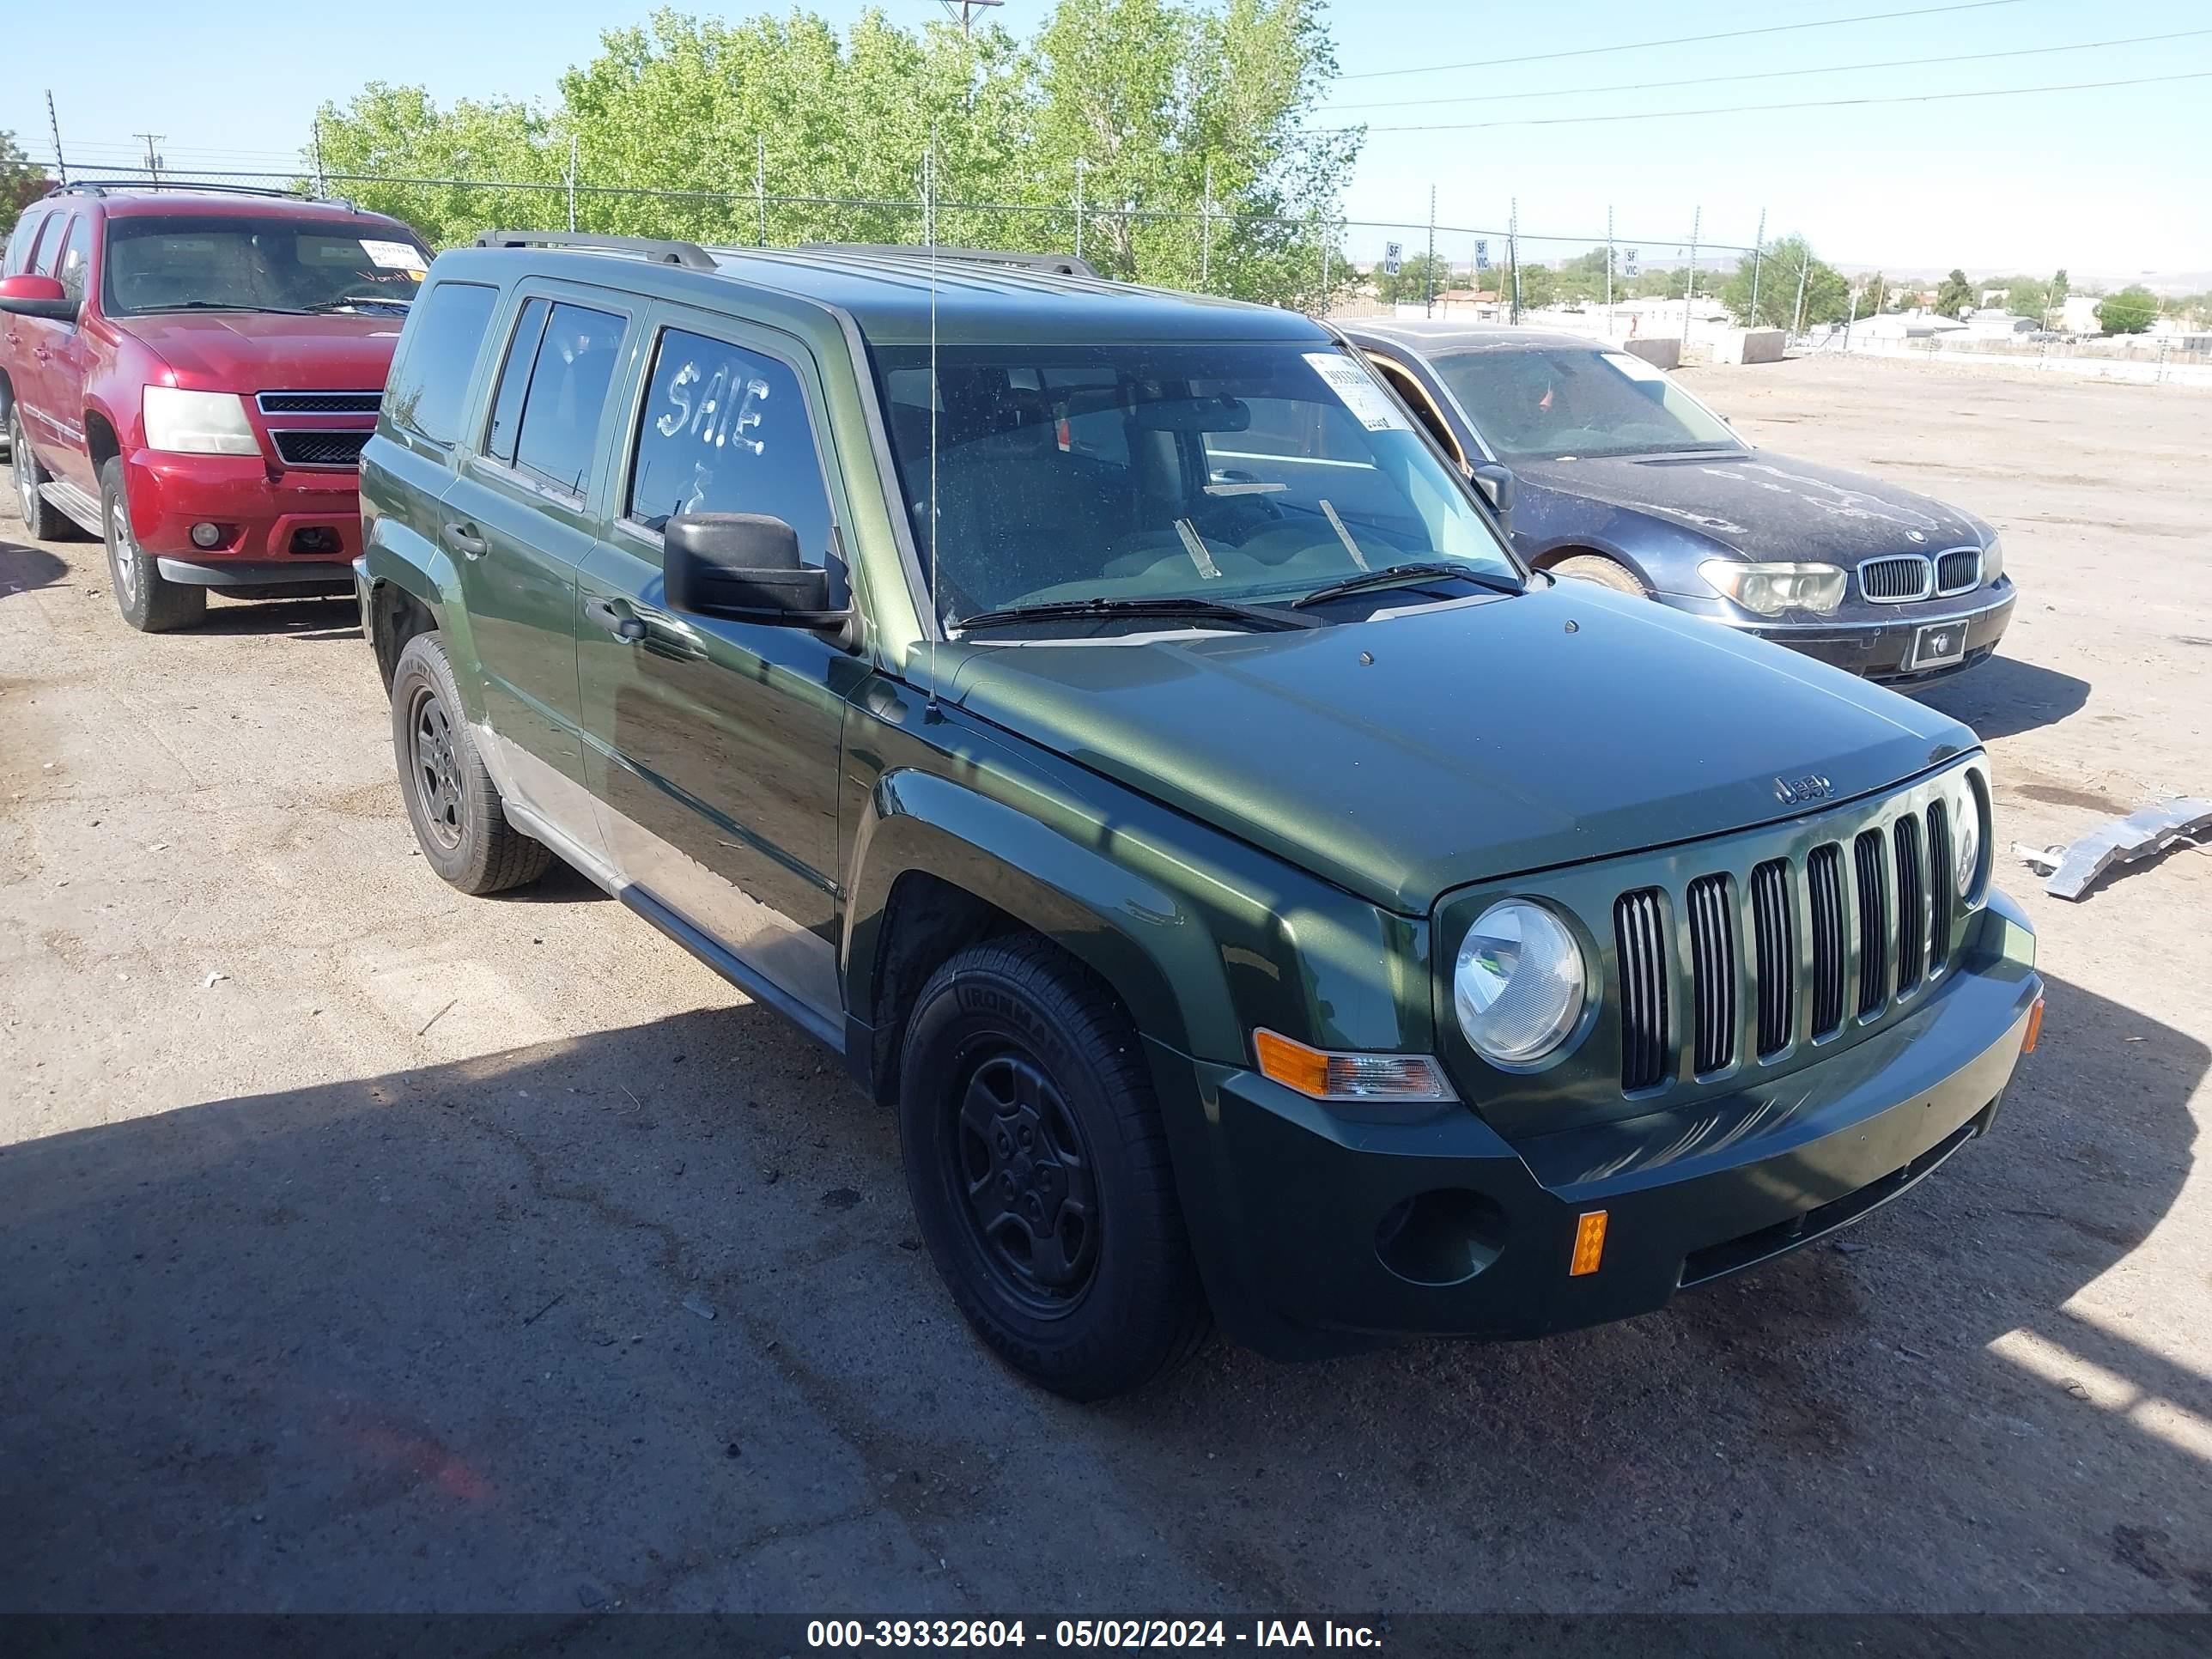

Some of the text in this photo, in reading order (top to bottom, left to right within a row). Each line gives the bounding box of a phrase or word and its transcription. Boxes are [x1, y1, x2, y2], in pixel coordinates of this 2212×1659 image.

[1389, 245, 1400, 258] SF
[1627, 251, 1636, 262] SF
[1386, 260, 1400, 274] VIC
[1476, 257, 1488, 269] VIC
[1625, 265, 1638, 276] VIC
[1773, 775, 1835, 805] Jeep
